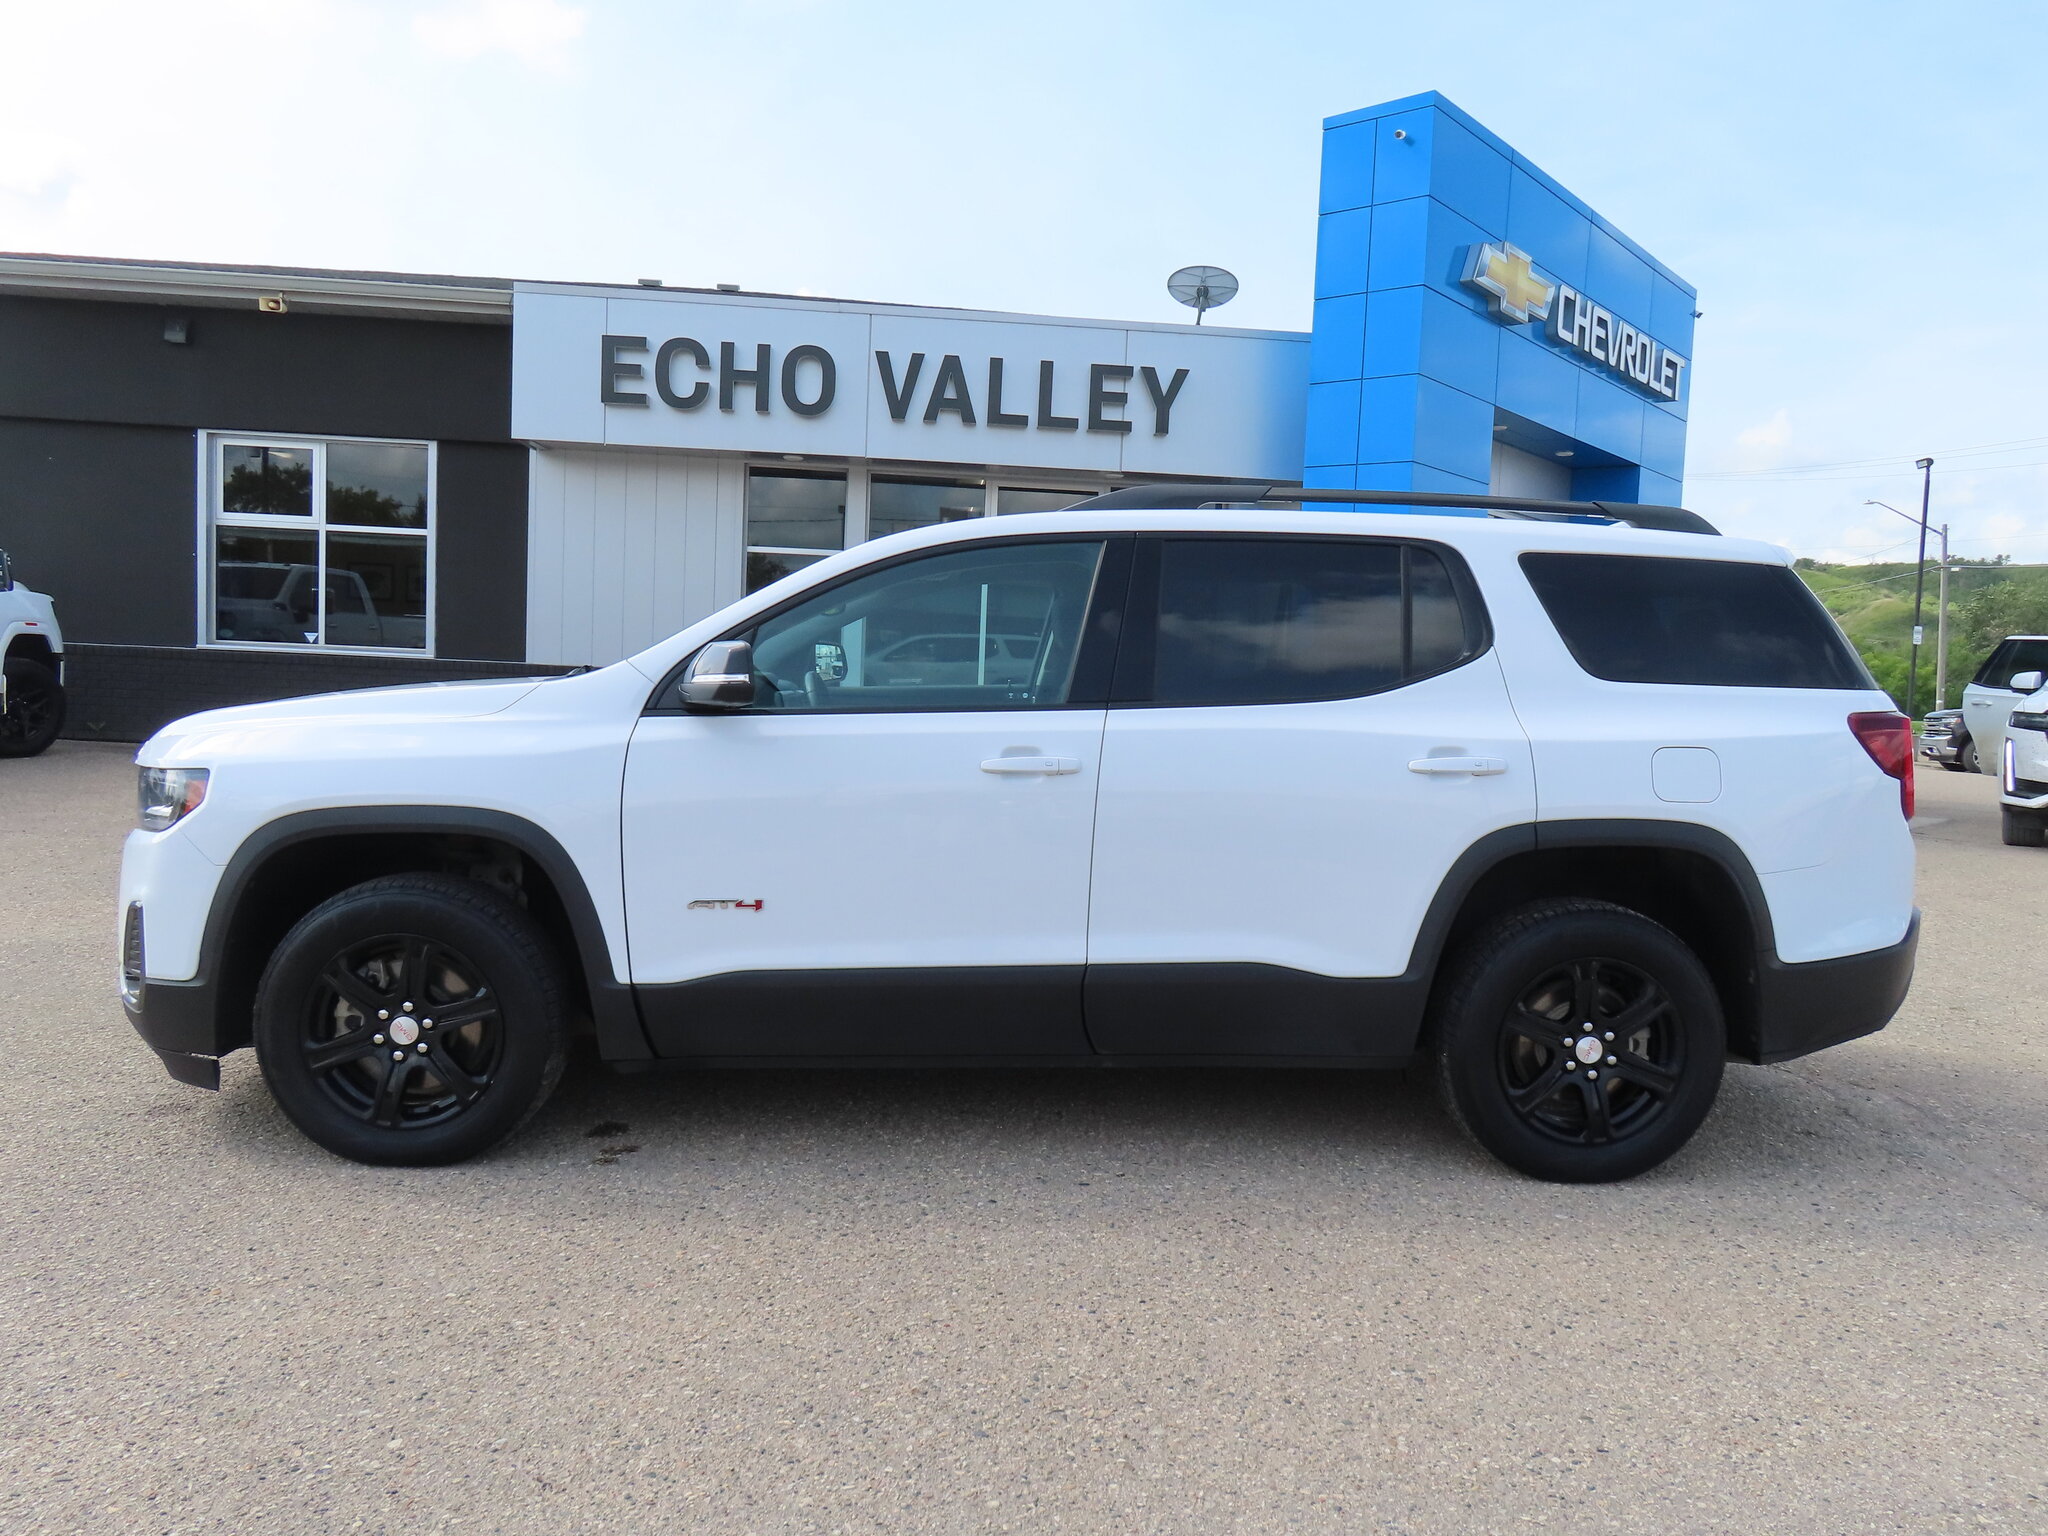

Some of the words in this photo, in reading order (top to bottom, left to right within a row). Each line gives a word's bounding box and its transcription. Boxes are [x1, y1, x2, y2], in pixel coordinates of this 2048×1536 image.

[601, 334, 836, 417] ECHO
[875, 350, 1190, 437] VALLEY
[1556, 284, 1685, 402] CHEVROLET
[687, 899, 763, 912] AT4
